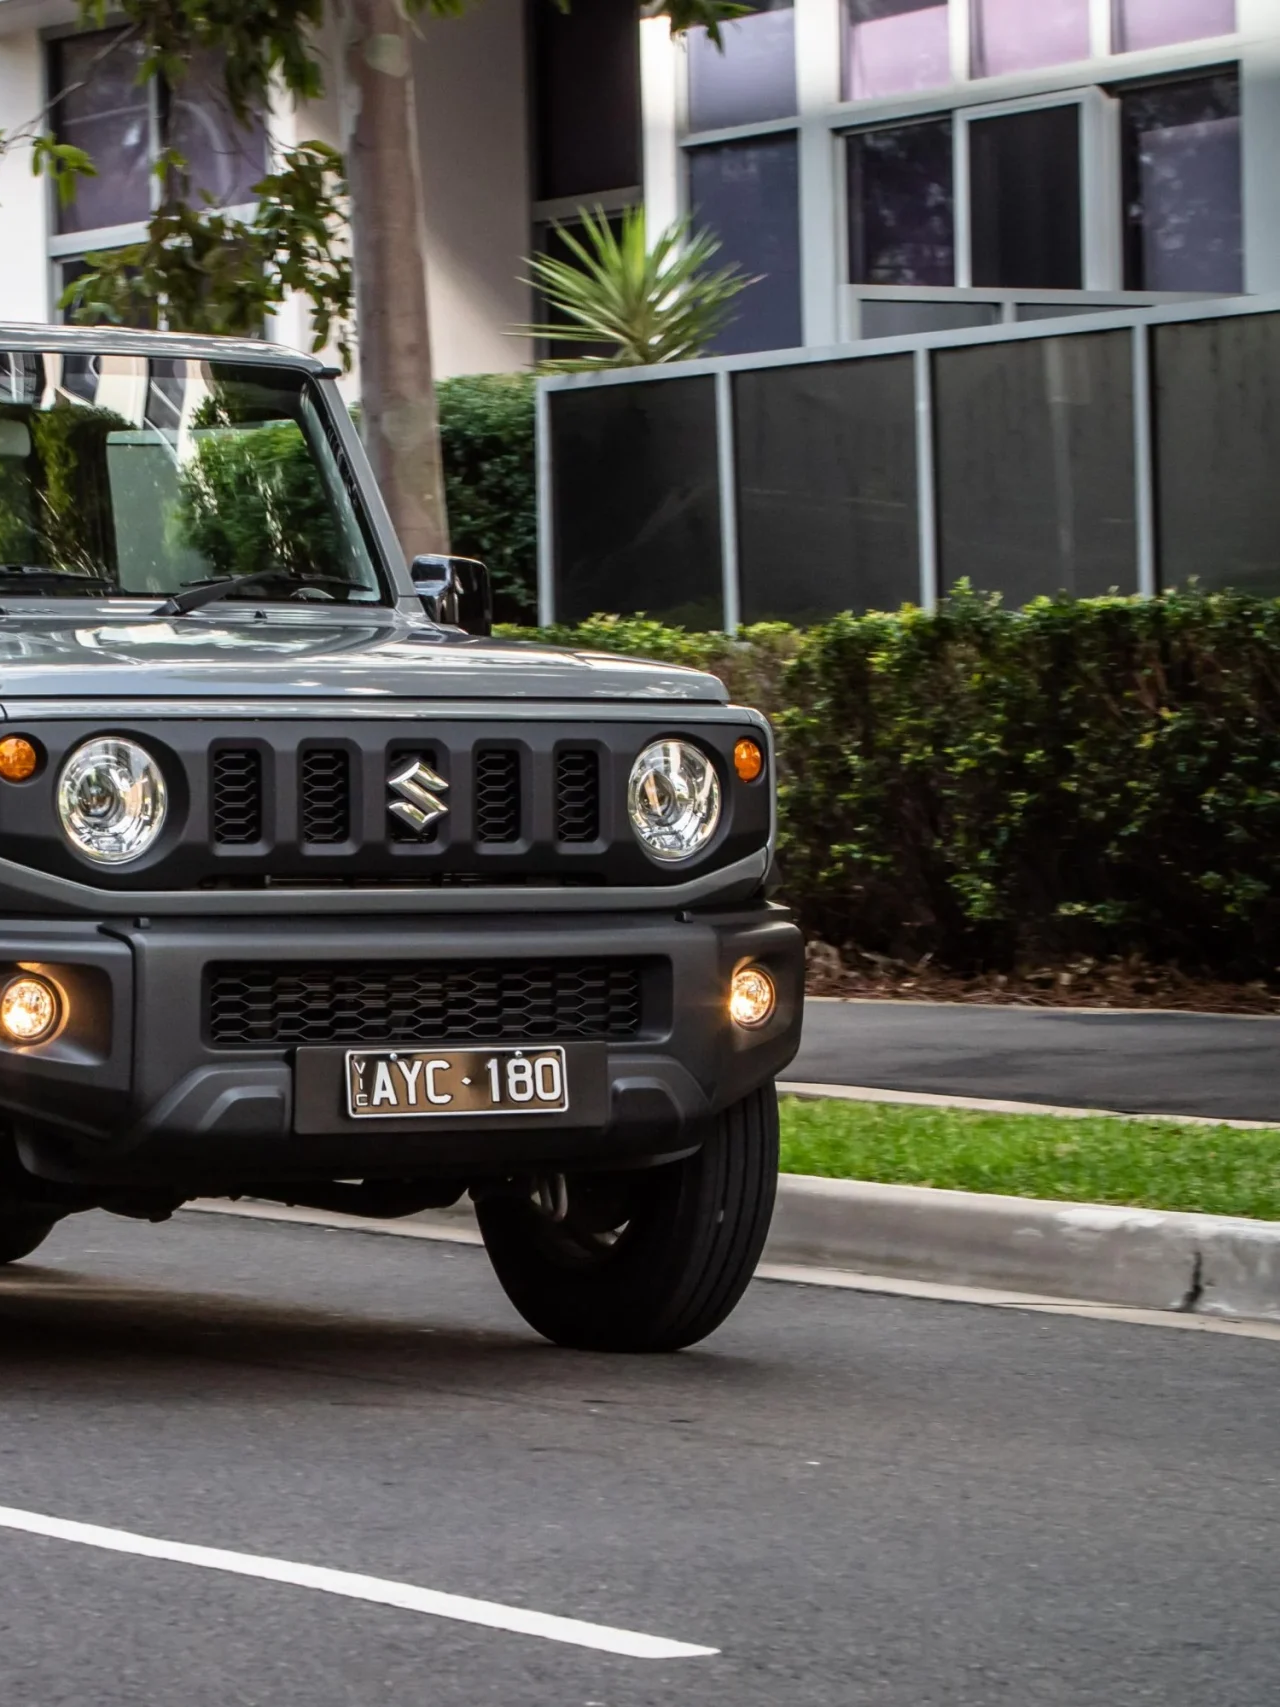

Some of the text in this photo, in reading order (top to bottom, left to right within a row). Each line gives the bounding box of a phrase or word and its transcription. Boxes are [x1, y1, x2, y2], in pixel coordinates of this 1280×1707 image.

[354, 1061, 369, 1107] VIC
[372, 1057, 562, 1106] AYC 180
